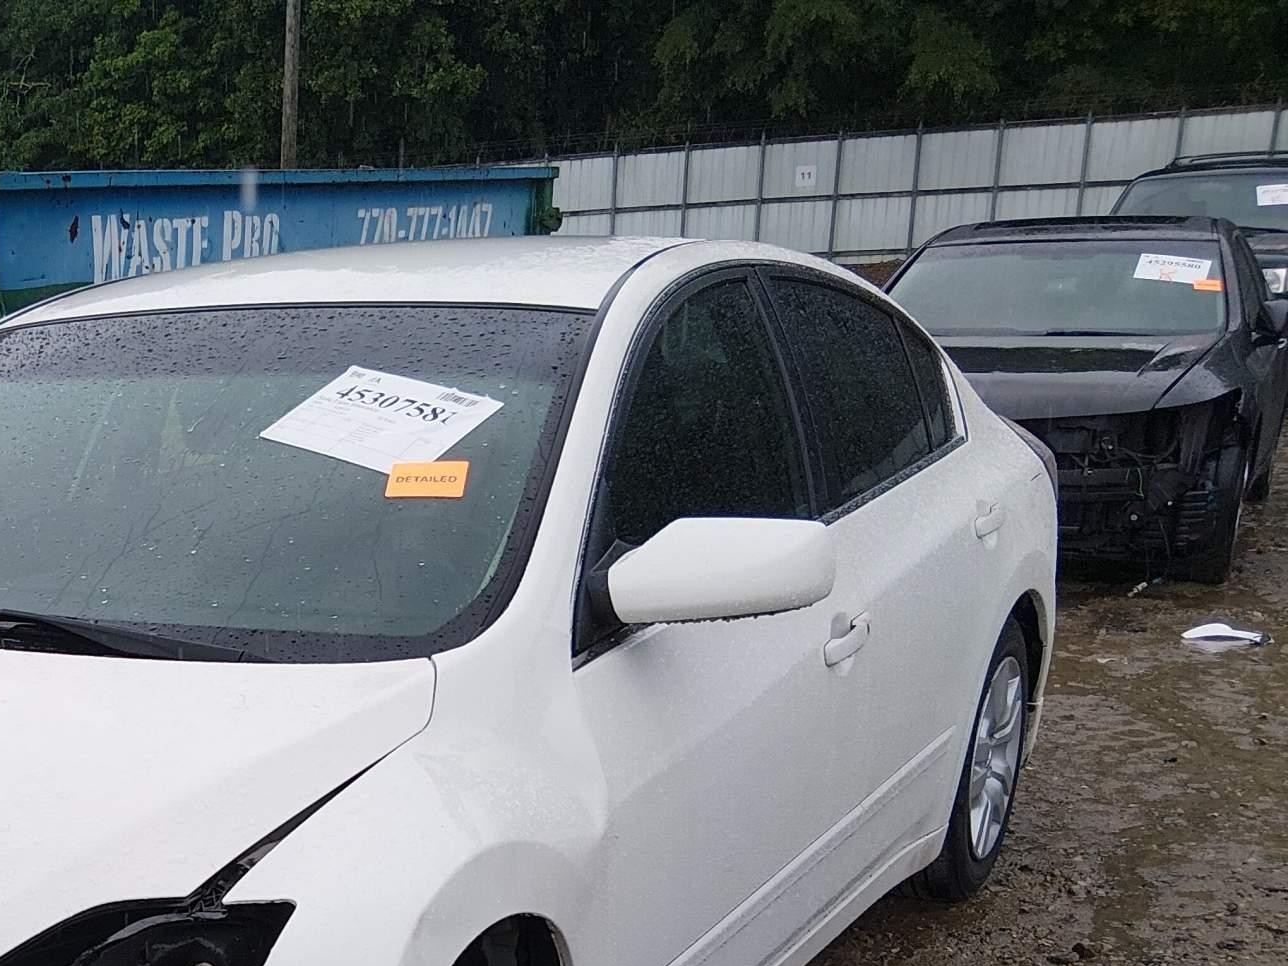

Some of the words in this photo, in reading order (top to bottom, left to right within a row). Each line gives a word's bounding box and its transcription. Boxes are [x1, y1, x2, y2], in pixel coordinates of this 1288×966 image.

[91, 213, 209, 285] WASTE
[222, 210, 280, 262] PRO
[335, 385, 458, 425] 45307581
[395, 475, 458, 484] DETAILED
